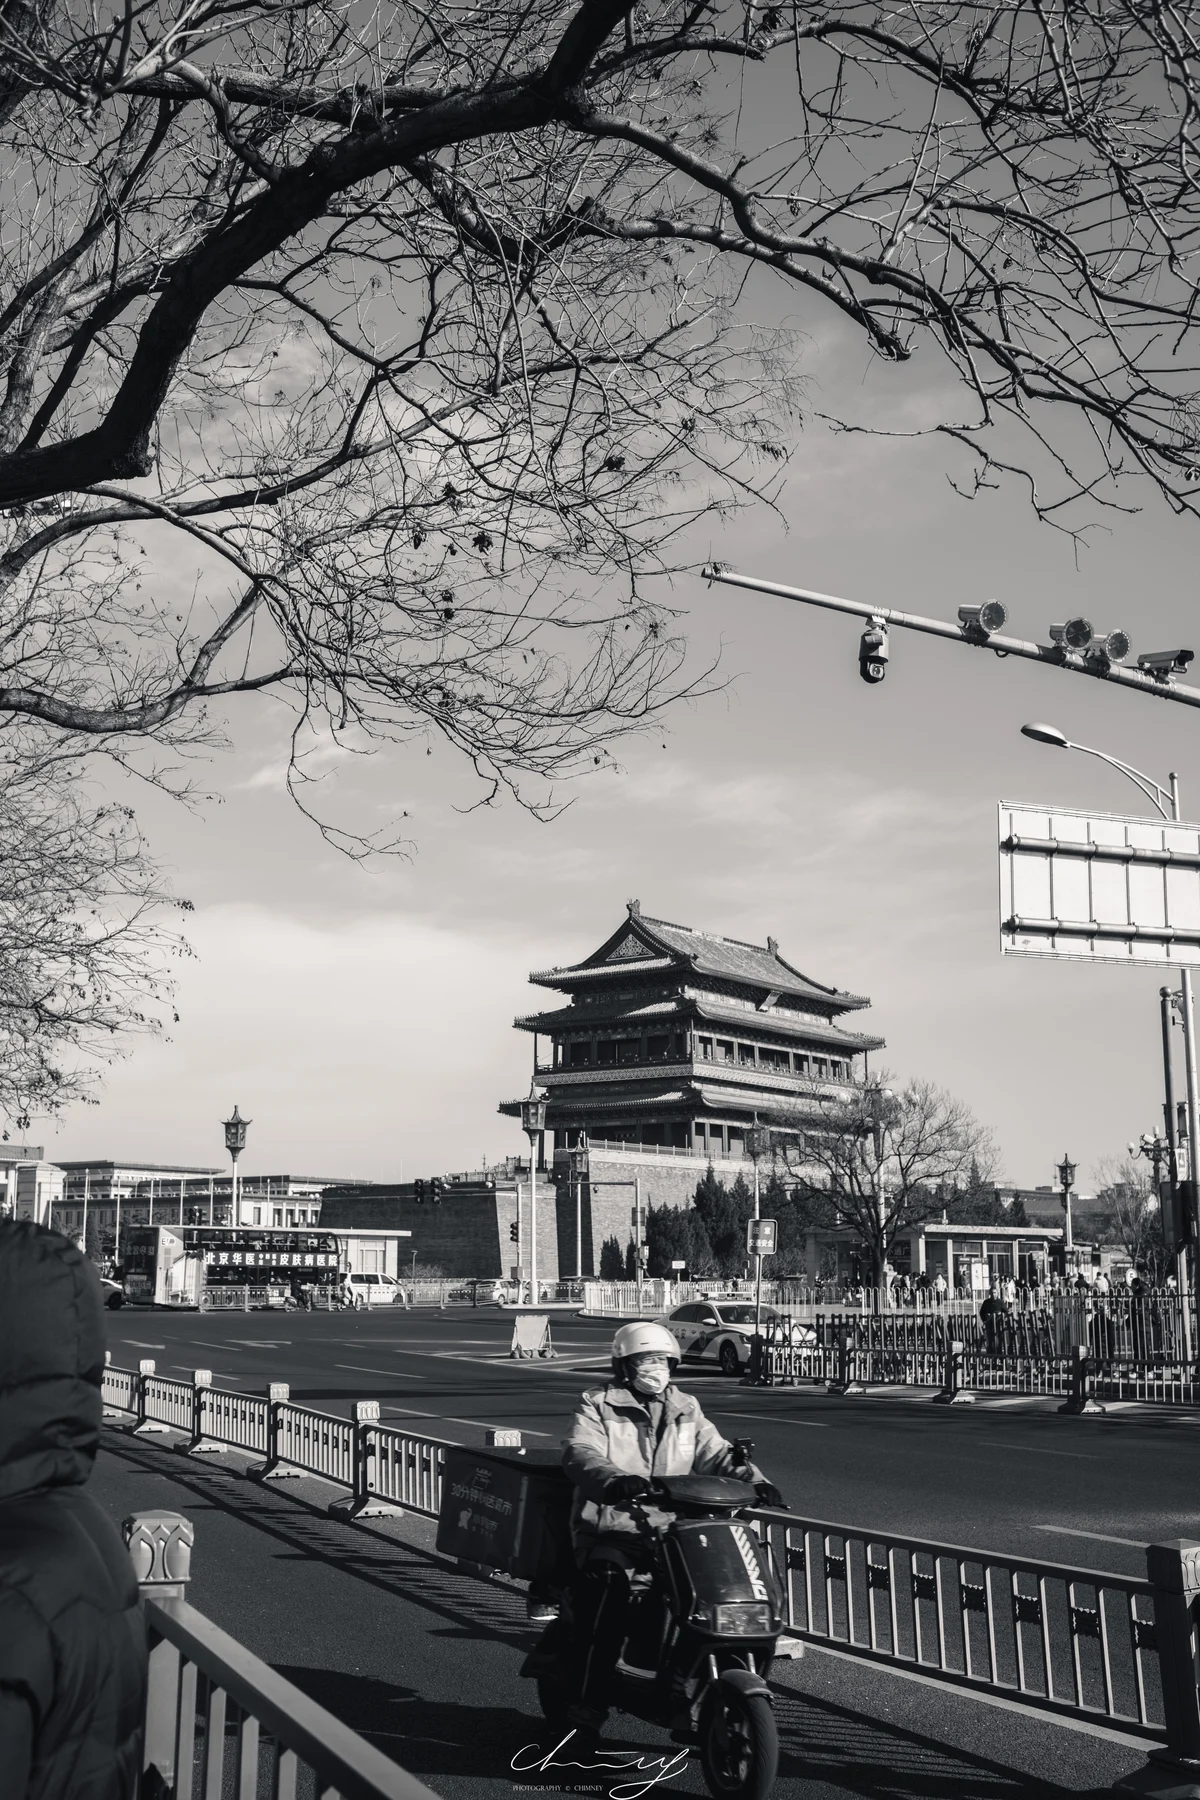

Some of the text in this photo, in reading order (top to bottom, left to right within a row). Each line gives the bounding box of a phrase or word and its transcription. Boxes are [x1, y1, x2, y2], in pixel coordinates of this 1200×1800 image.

[752, 1226, 772, 1235] 注意
[748, 1238, 774, 1248] 交通安全
[206, 1252, 255, 1265] 北京华医
[280, 1253, 338, 1266] 皮肤病医院
